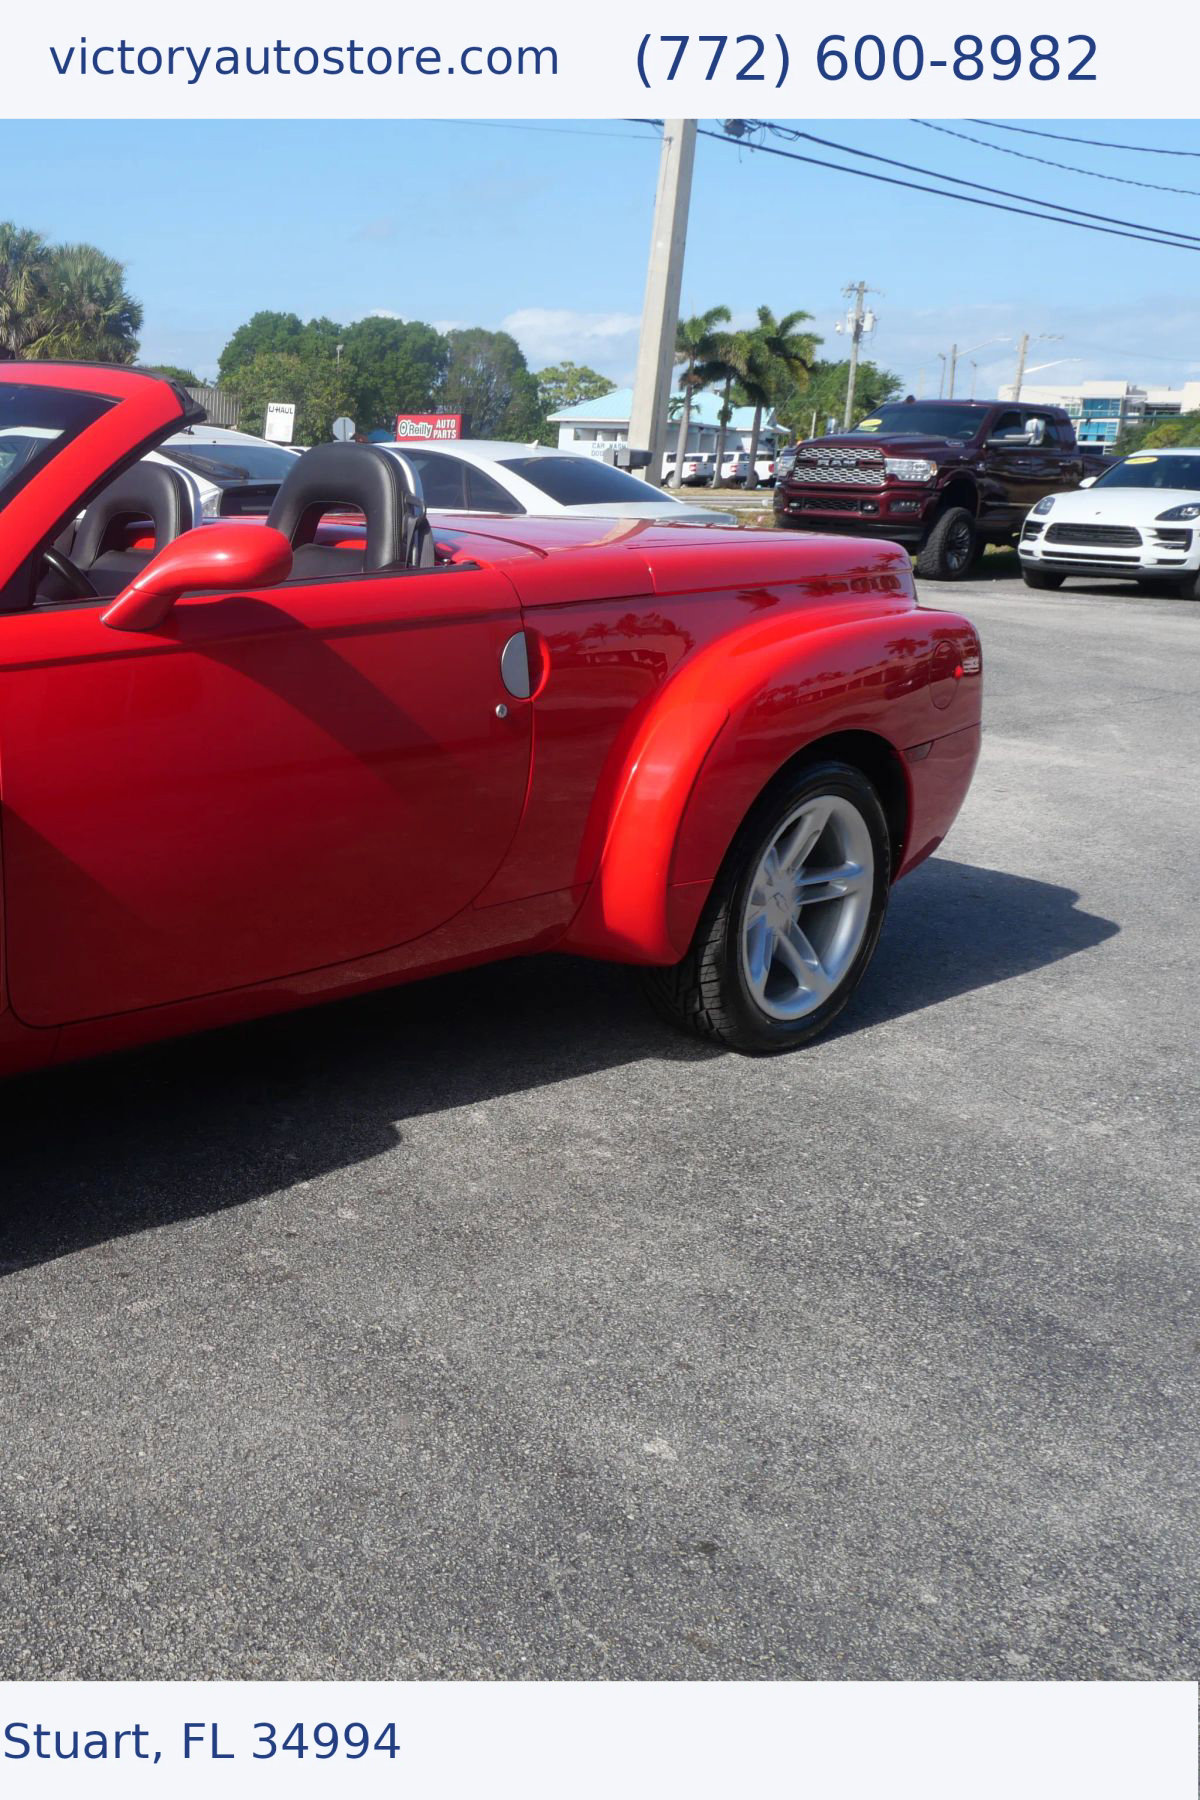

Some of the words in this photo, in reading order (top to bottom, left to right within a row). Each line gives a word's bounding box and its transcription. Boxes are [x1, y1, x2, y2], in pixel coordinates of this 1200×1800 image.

[268, 406, 294, 414] U-HAUL
[399, 420, 433, 438] O'Reilly
[436, 419, 456, 429] AUTO
[433, 429, 457, 439] PARTS
[817, 459, 857, 468] RAM
